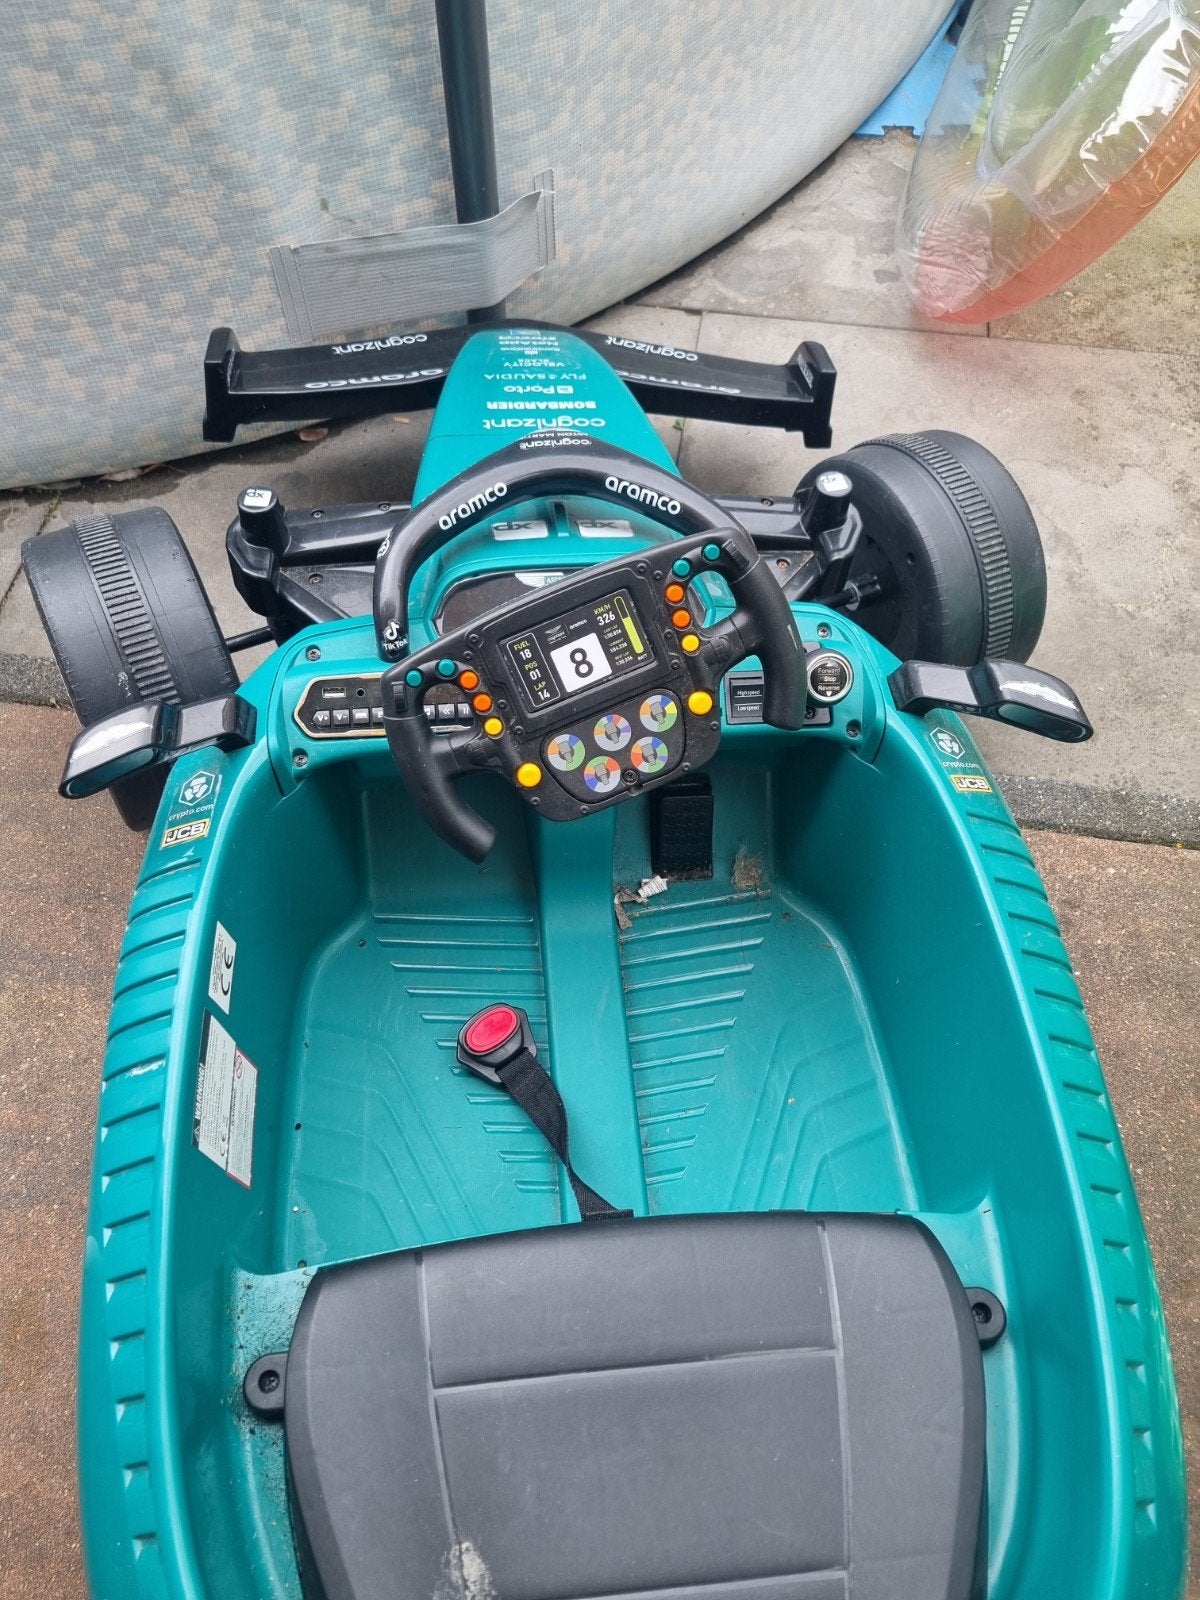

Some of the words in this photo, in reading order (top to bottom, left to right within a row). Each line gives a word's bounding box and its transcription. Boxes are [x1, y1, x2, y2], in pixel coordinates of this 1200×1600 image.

[332, 333, 427, 355] cognizant
[606, 335, 698, 362] cognizant
[305, 367, 444, 389] aramco
[486, 400, 597, 410] BOMBARDIER
[482, 415, 606, 430] cognizant
[519, 437, 591, 450] cognizant
[605, 476, 681, 515] aramco
[438, 482, 507, 531] aramco
[594, 604, 611, 615] KM/H
[597, 611, 615, 626] 326
[383, 638, 408, 650] TikTok
[514, 640, 530, 651] FUEL
[520, 648, 532, 660] 18
[524, 661, 538, 671] POS
[570, 647, 594, 678] 8
[529, 669, 541, 680] 01
[534, 681, 546, 691] LAP
[538, 689, 551, 700] 14
[957, 778, 988, 789] JCB
[169, 803, 214, 821] crypto.com
[166, 822, 206, 843] JCB
[195, 1063, 205, 1119] WARNING!
